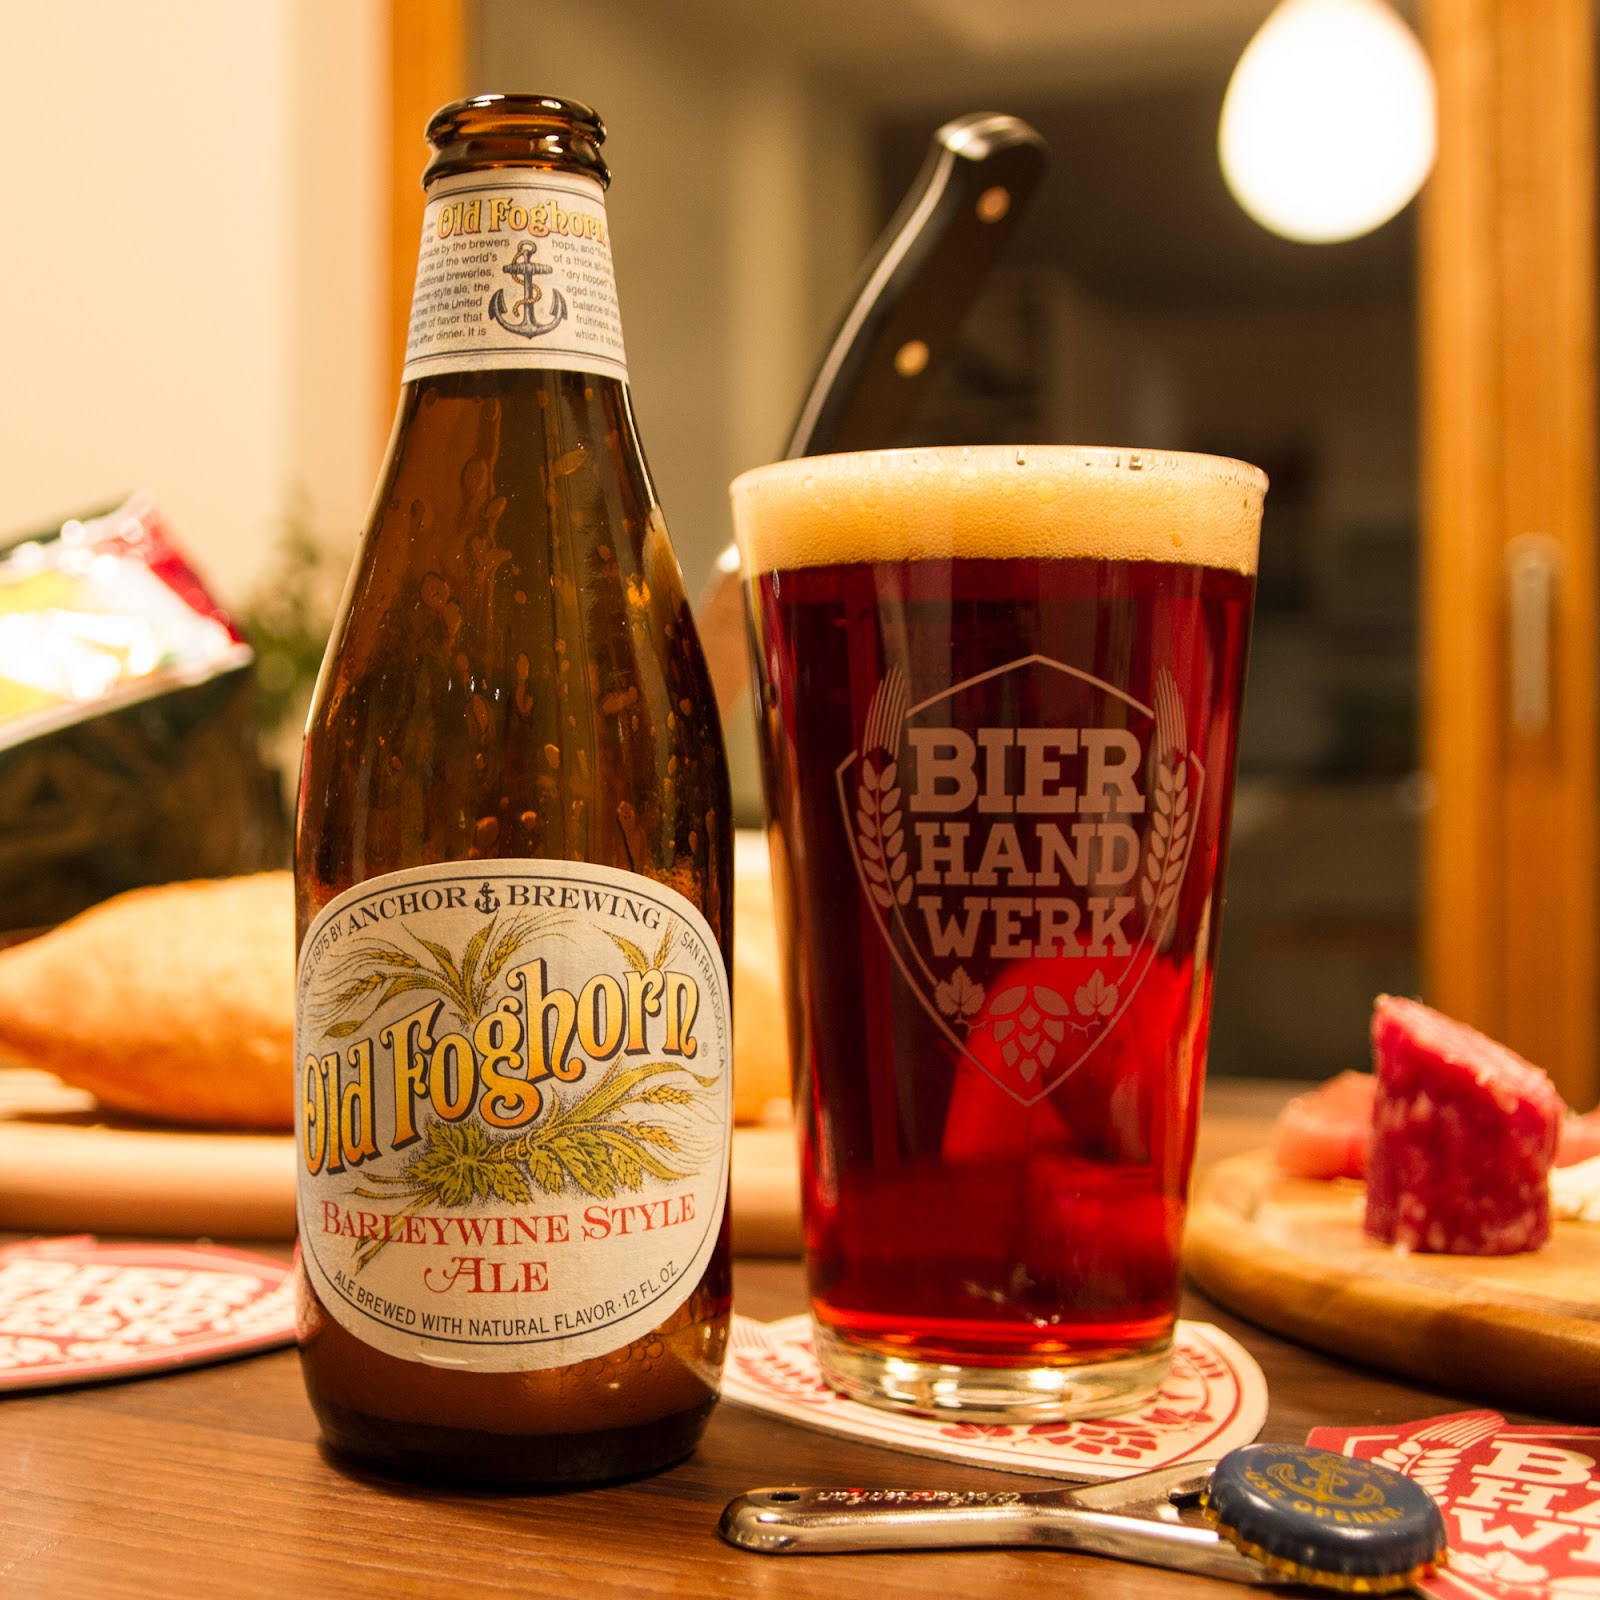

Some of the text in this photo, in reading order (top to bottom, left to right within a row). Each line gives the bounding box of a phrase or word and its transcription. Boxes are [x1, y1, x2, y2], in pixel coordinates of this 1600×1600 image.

[437, 197, 607, 247] Old Foghorn
[441, 246, 451, 255] by
[453, 241, 467, 251] the
[469, 238, 510, 249] brewers
[436, 261, 444, 269] of
[446, 257, 459, 265] the
[461, 252, 498, 263] world's
[553, 254, 562, 264] of
[566, 256, 571, 264] a
[574, 256, 592, 268] thick
[446, 268, 495, 279] breweries,
[454, 284, 470, 294] ale,
[474, 283, 490, 292] the
[566, 286, 587, 297] aged
[430, 304, 436, 314] in
[437, 302, 449, 311] the
[451, 297, 483, 309] United
[572, 300, 602, 314] balance
[437, 313, 460, 326] flavor
[463, 312, 483, 322] that
[436, 328, 465, 340] dinner.
[468, 327, 474, 336] It
[478, 327, 486, 336] is
[908, 728, 1145, 813] BIER
[914, 822, 1140, 887] HAND
[312, 933, 330, 963] 1975
[329, 920, 343, 942] BY
[347, 885, 468, 936] ANCHOR
[507, 884, 661, 930] BREWING
[681, 931, 701, 961] SAN
[917, 895, 1136, 958] WERK
[303, 1037, 383, 1177] Old
[379, 957, 699, 1151] Foghorn
[320, 1193, 696, 1247] BARLEYWINE STYLE
[424, 1256, 549, 1294] ALE
[334, 1270, 356, 1297] ALE
[356, 1286, 416, 1326] BREWED
[421, 1312, 462, 1335] WITH
[468, 1316, 550, 1337] NATURAL
[639, 1278, 661, 1299] FL.
[659, 1260, 680, 1284] OZ.
